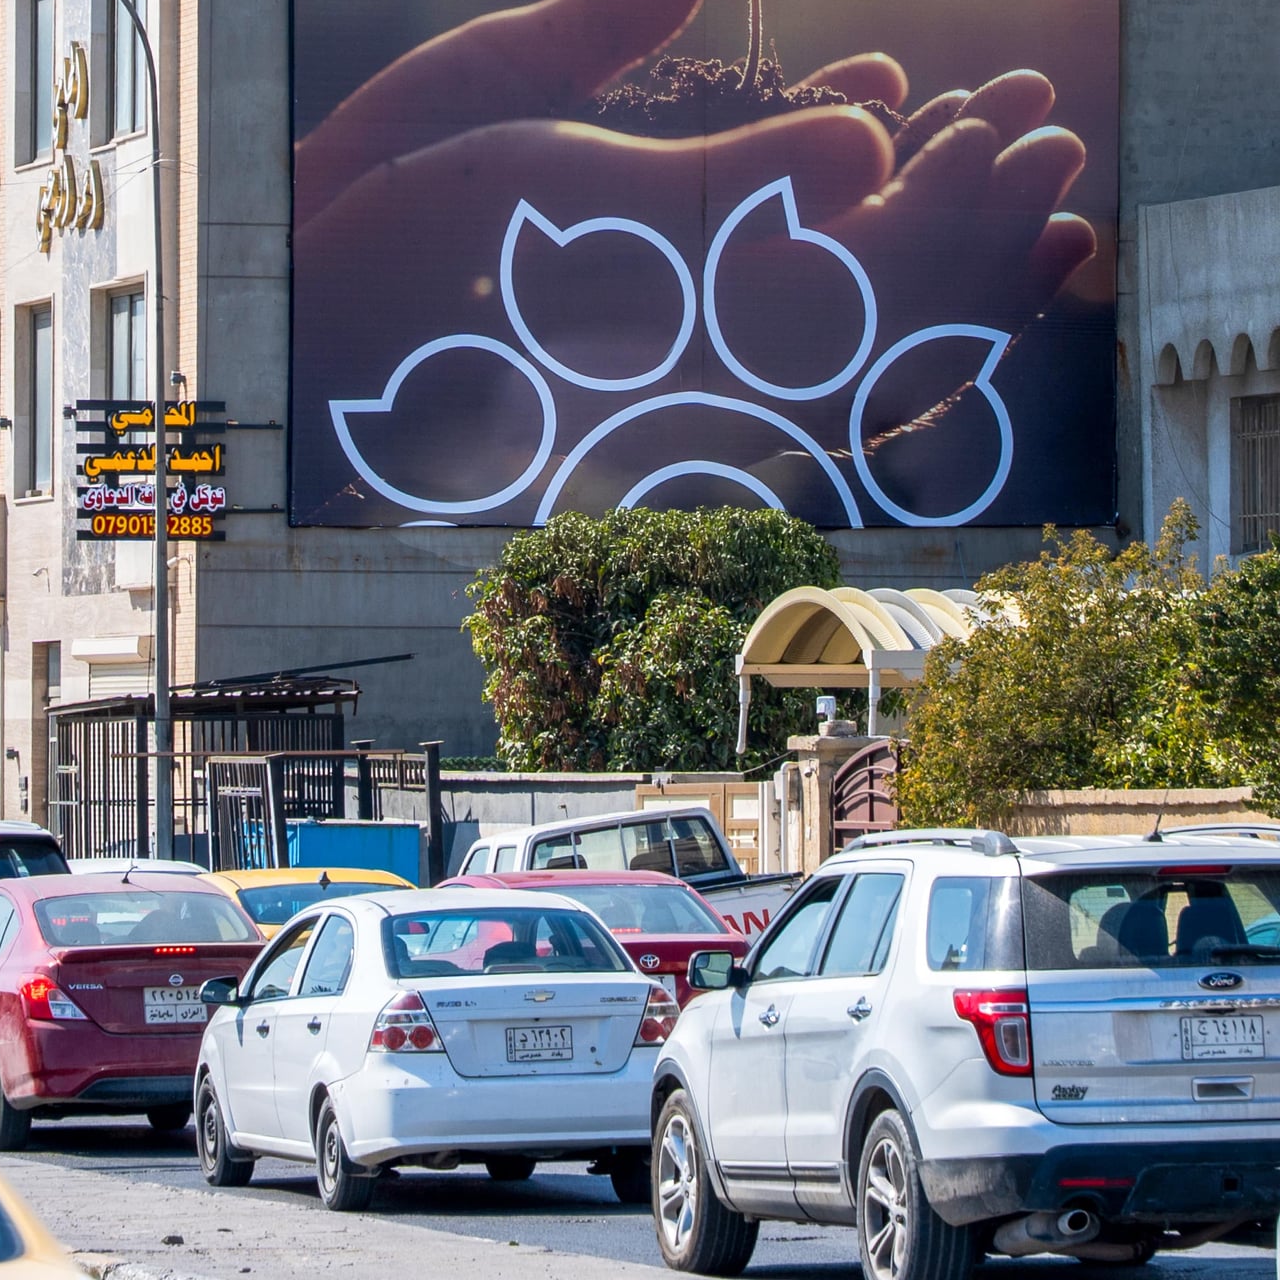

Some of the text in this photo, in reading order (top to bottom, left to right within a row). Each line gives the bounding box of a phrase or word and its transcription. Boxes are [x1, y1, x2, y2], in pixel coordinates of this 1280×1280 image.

[111, 401, 195, 435] المحمي
[85, 444, 221, 482] احمد لدعمي
[172, 483, 187, 513] في
[93, 515, 212, 536] 0790152885
[1208, 975, 1235, 986] Ford
